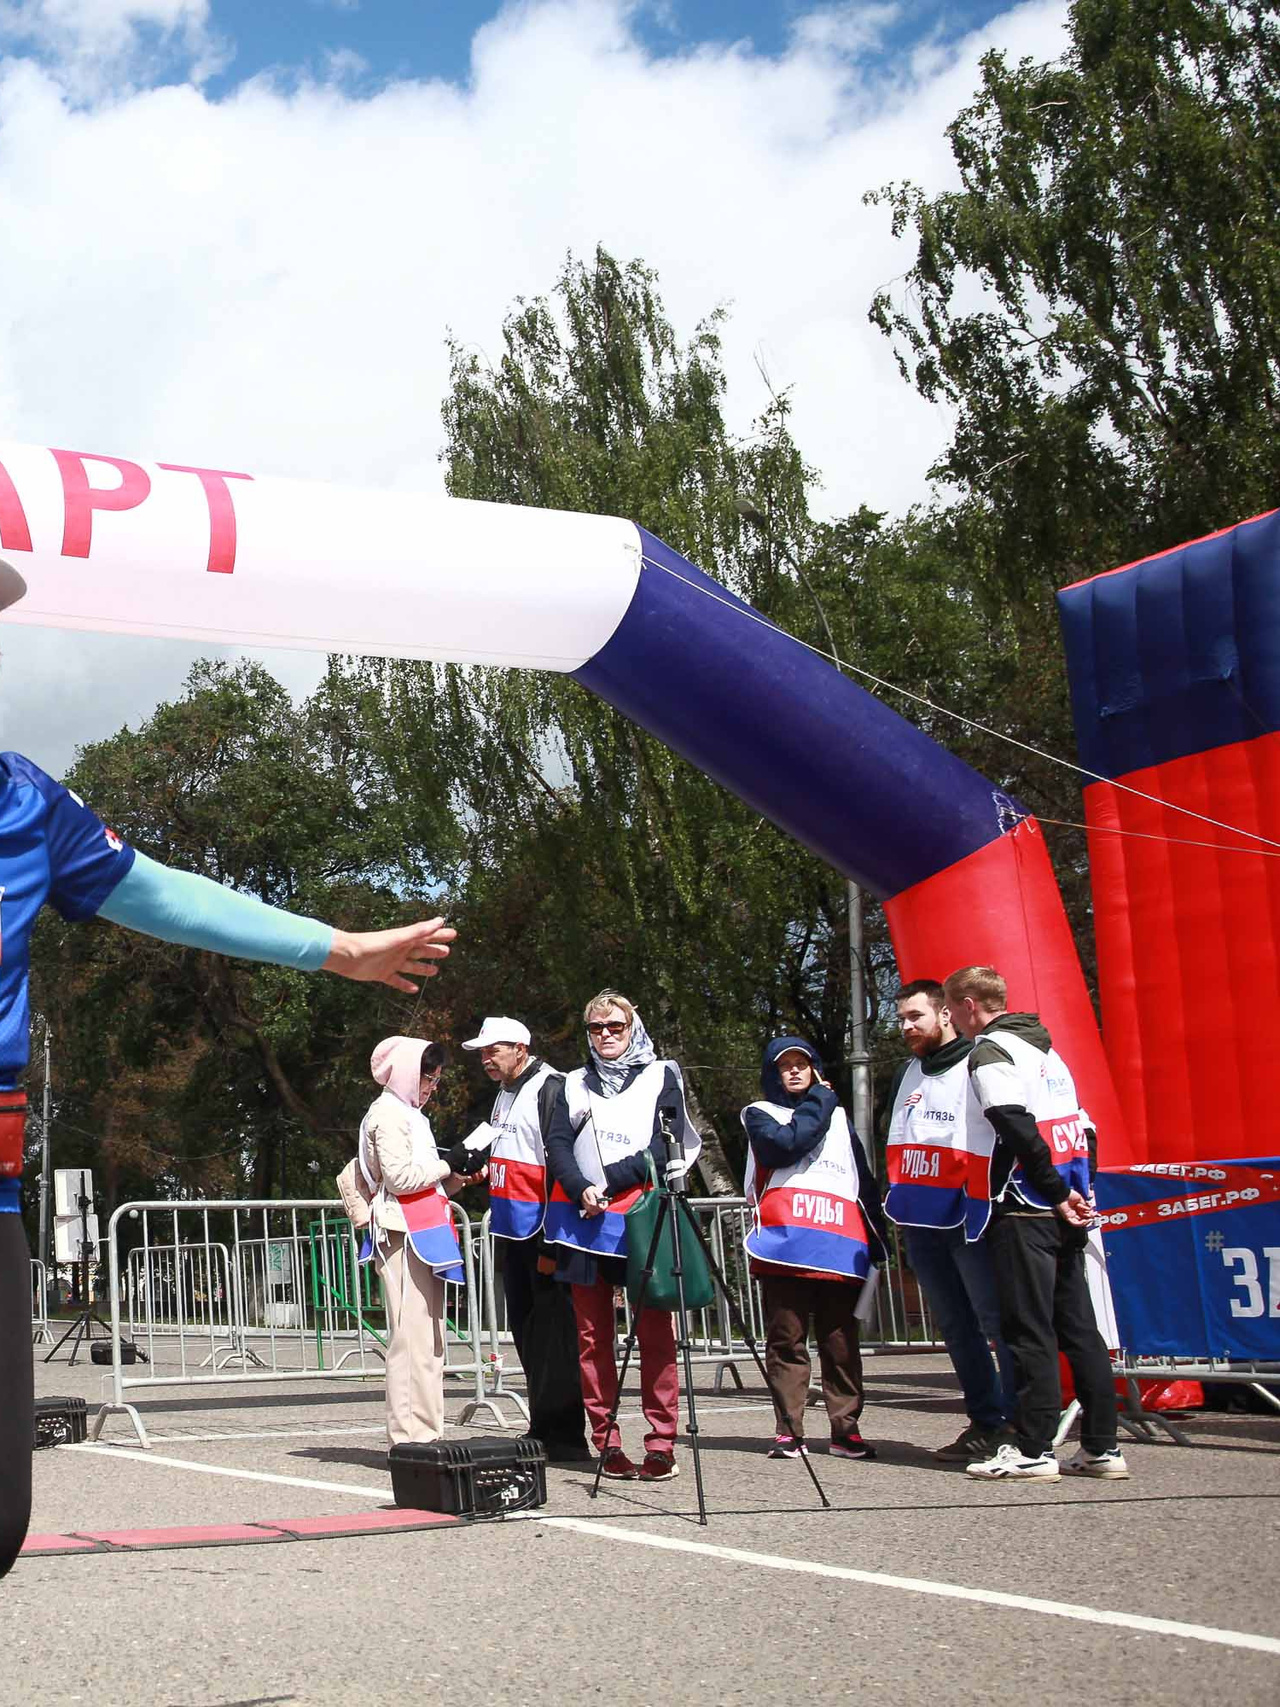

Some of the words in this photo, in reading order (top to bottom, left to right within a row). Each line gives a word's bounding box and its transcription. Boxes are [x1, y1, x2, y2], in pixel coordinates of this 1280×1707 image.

[917, 1109, 956, 1122] ИТЯЗЬ
[792, 1192, 845, 1227] СУДЬЯ
[1157, 1187, 1260, 1217] ЗАБЕГ.РФ
